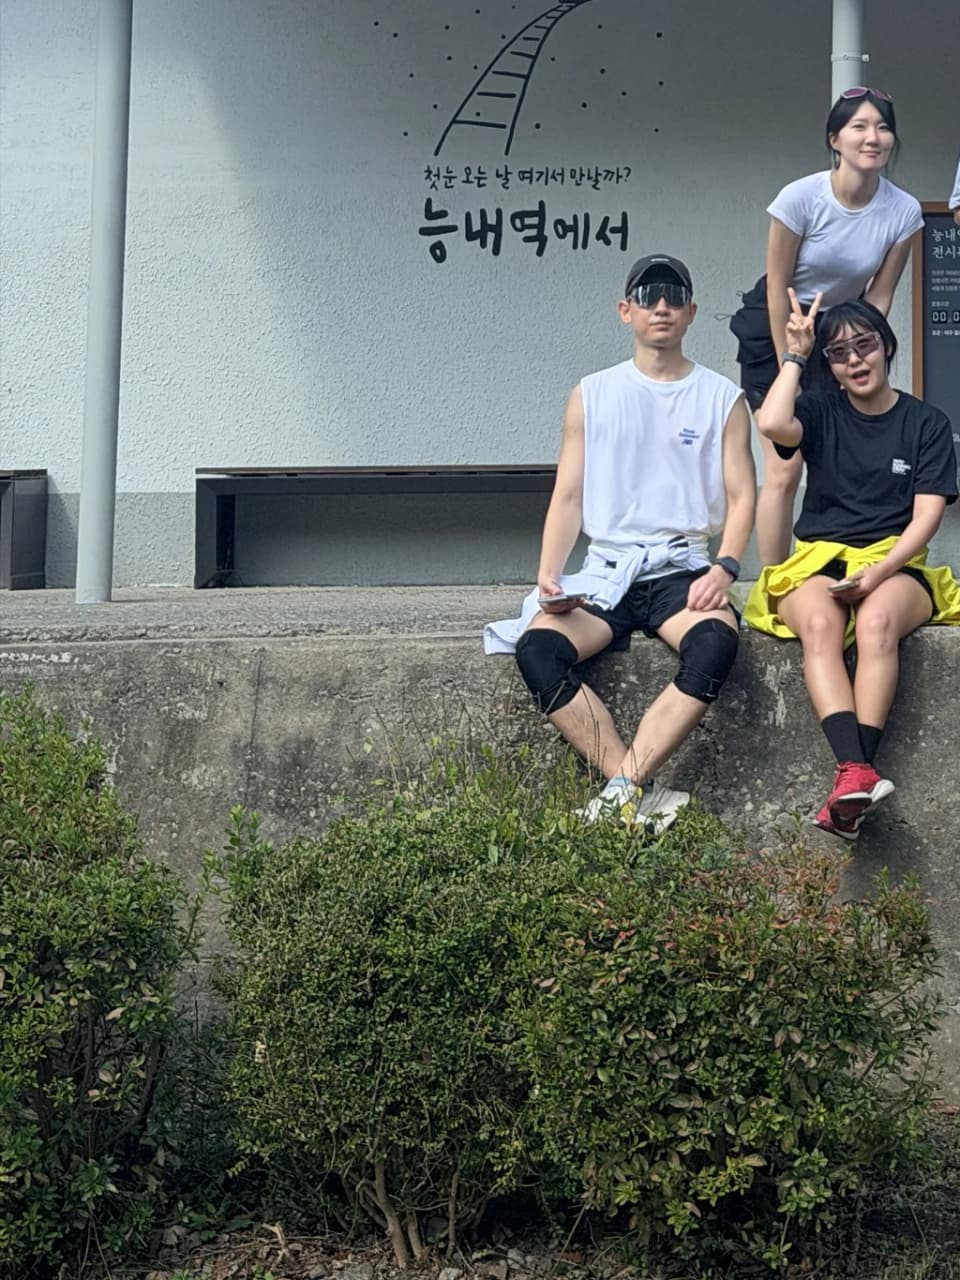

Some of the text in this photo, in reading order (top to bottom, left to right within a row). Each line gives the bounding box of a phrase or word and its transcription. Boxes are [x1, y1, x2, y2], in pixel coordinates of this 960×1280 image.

[461, 165, 488, 189] 오는
[495, 164, 513, 190] 날
[518, 166, 565, 186] 여기서
[569, 166, 632, 190] 만날까?
[418, 197, 629, 264] 능내역에서
